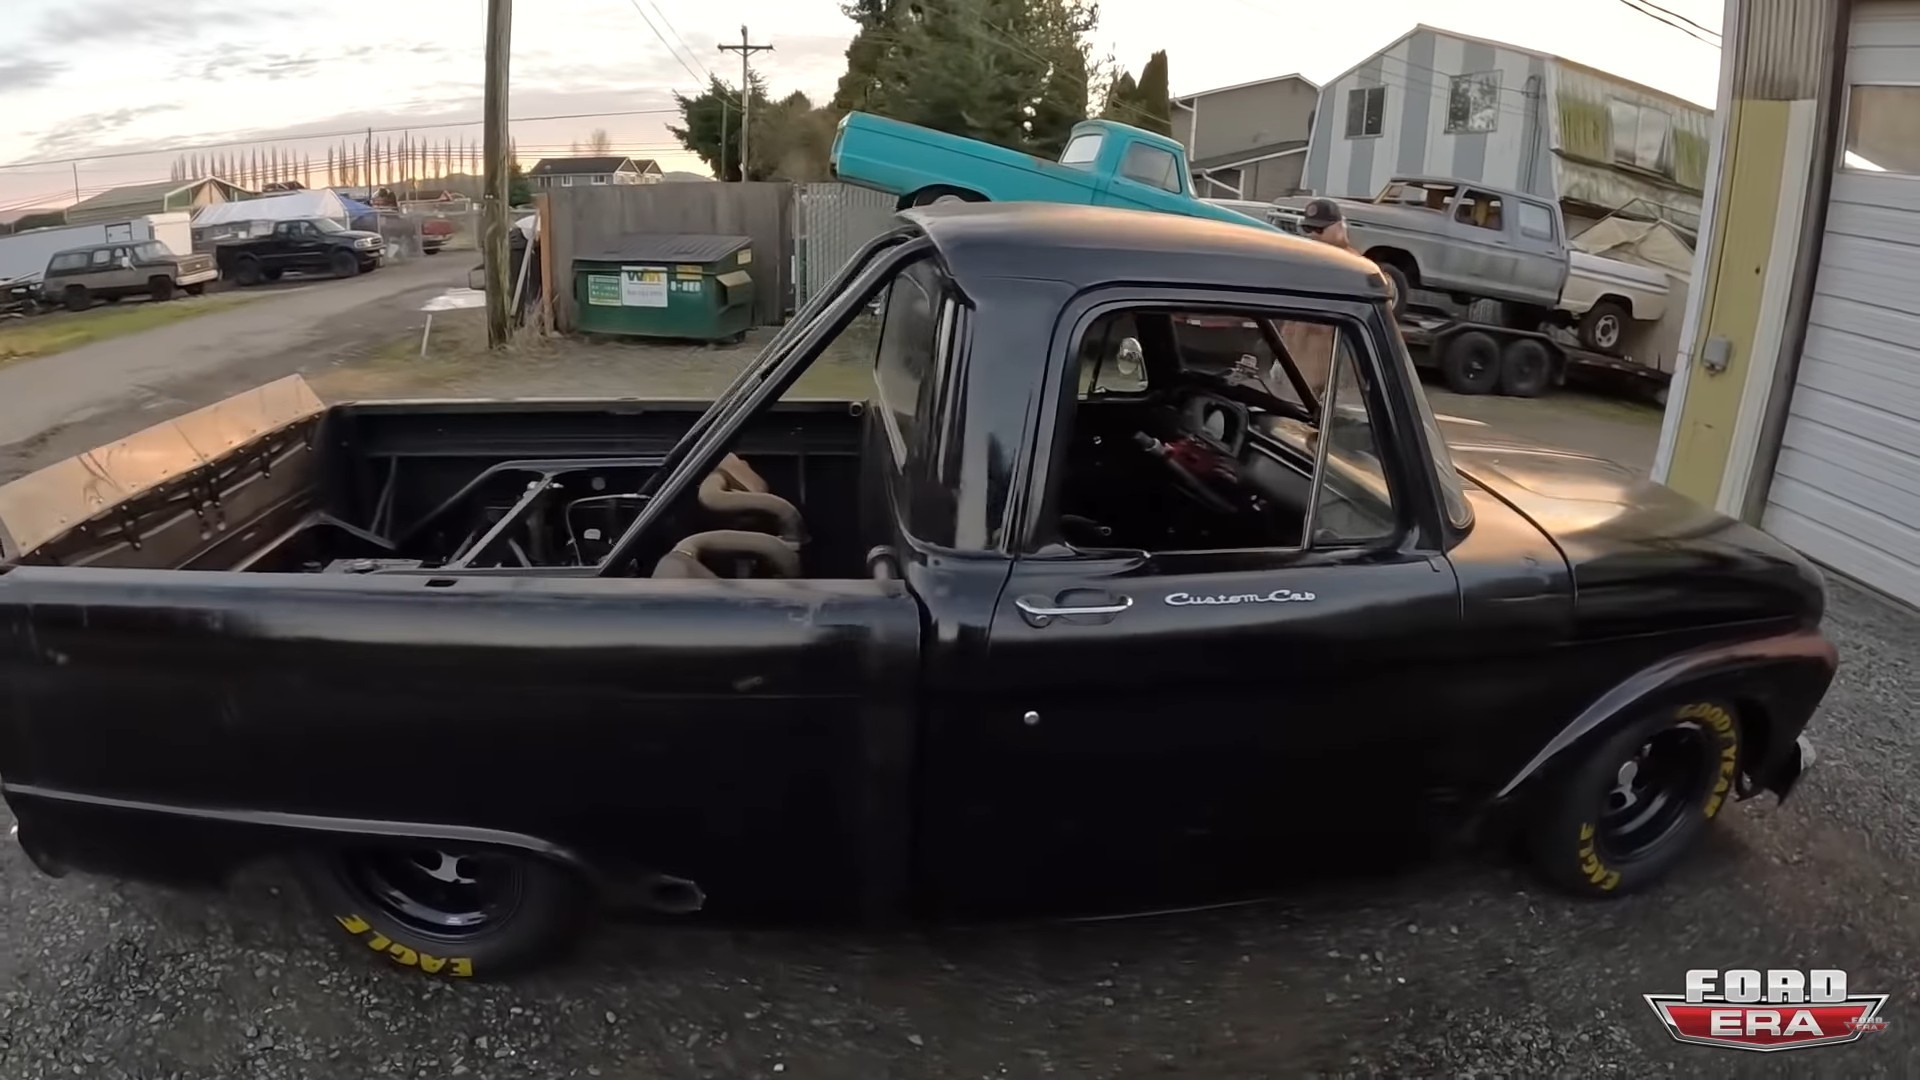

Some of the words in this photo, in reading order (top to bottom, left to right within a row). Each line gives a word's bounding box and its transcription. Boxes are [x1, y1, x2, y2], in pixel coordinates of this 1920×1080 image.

[1164, 592, 1259, 606] Custom
[1267, 589, 1316, 602] Cab
[1579, 821, 1621, 890] EAGLE
[334, 913, 473, 977] EAGLE
